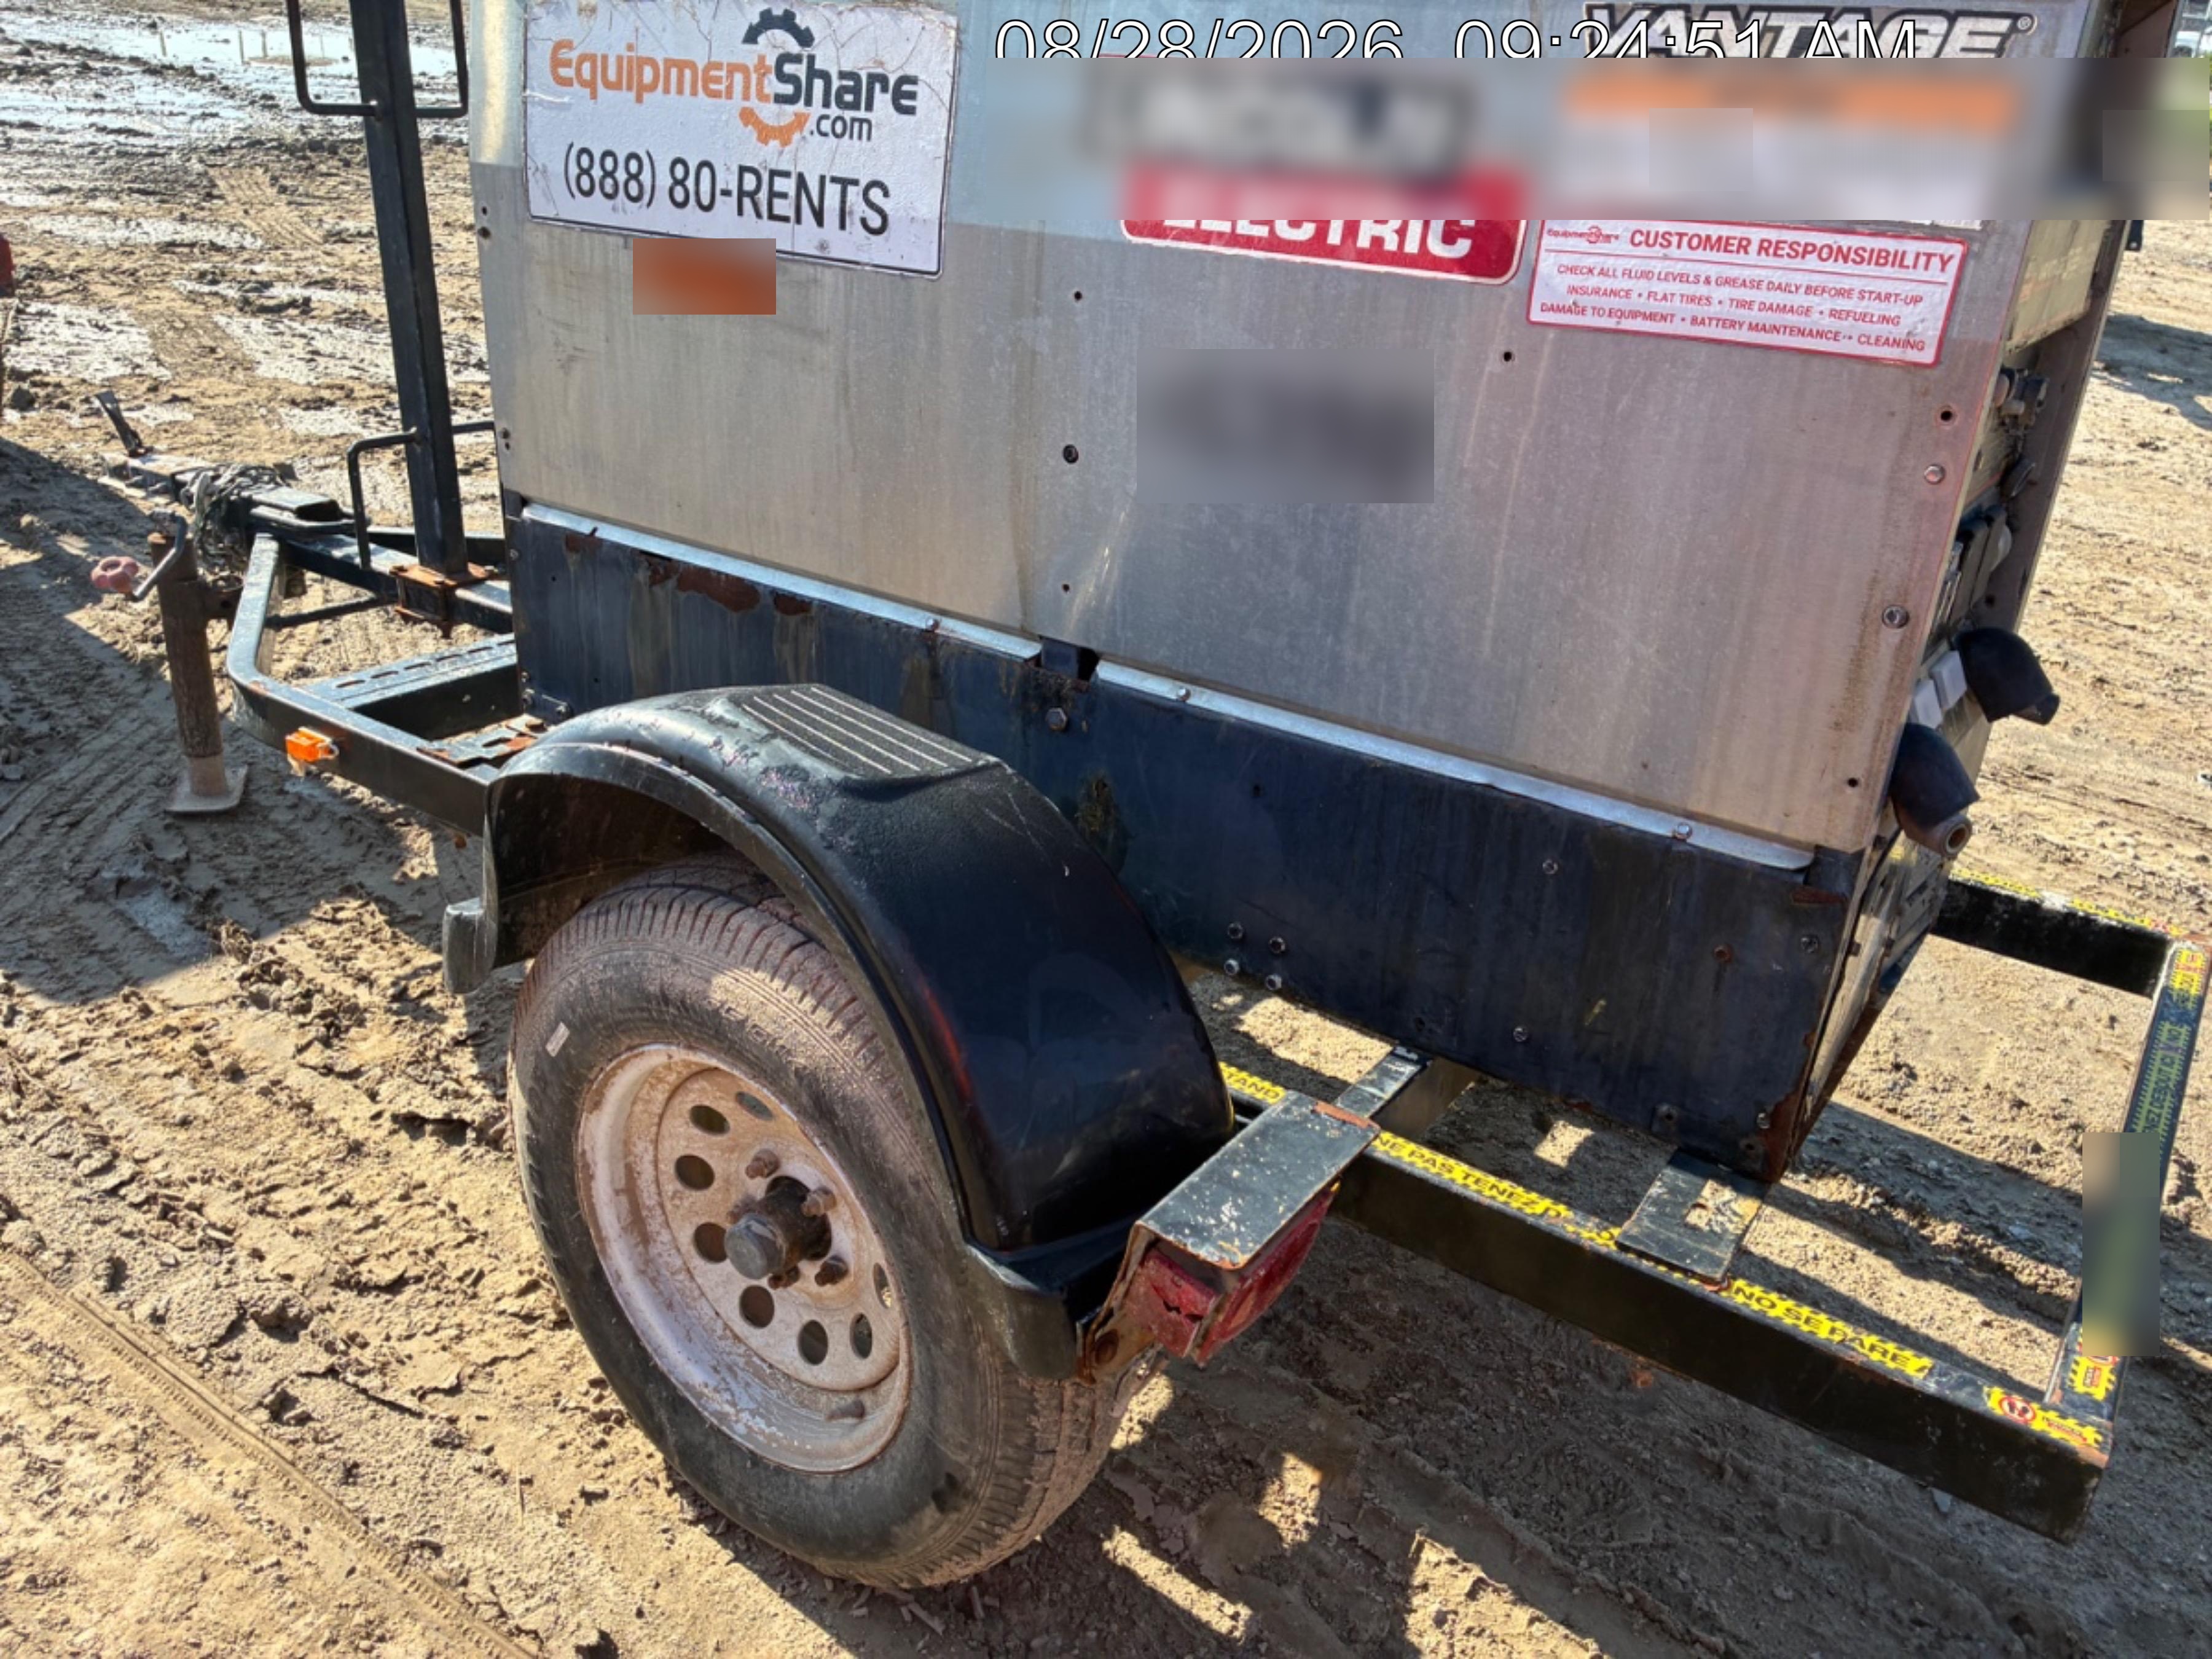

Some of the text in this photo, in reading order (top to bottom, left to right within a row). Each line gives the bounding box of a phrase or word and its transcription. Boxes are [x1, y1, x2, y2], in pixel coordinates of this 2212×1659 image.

[549, 38, 919, 116] EquipmentShare
[810, 112, 873, 142] .com
[563, 141, 890, 237] (888) 80-RENTS
[1630, 229, 1955, 273] CUSTOMER RESPONSIBILITY
[1558, 265, 1923, 307] CHECK ALL FLUID LEVELS & GREASE DAILY BEFORE START-UP
[1567, 284, 1901, 326] INSURANCE FLAT TIRES TIRE DAMAGE REFUELING
[1540, 302, 1925, 351] DAMAGE TO EQUIPMENT BATTERY MAINTENANCE CLEANING
[1734, 1287, 1777, 1309] NO
[1783, 1307, 1823, 1329] SE
